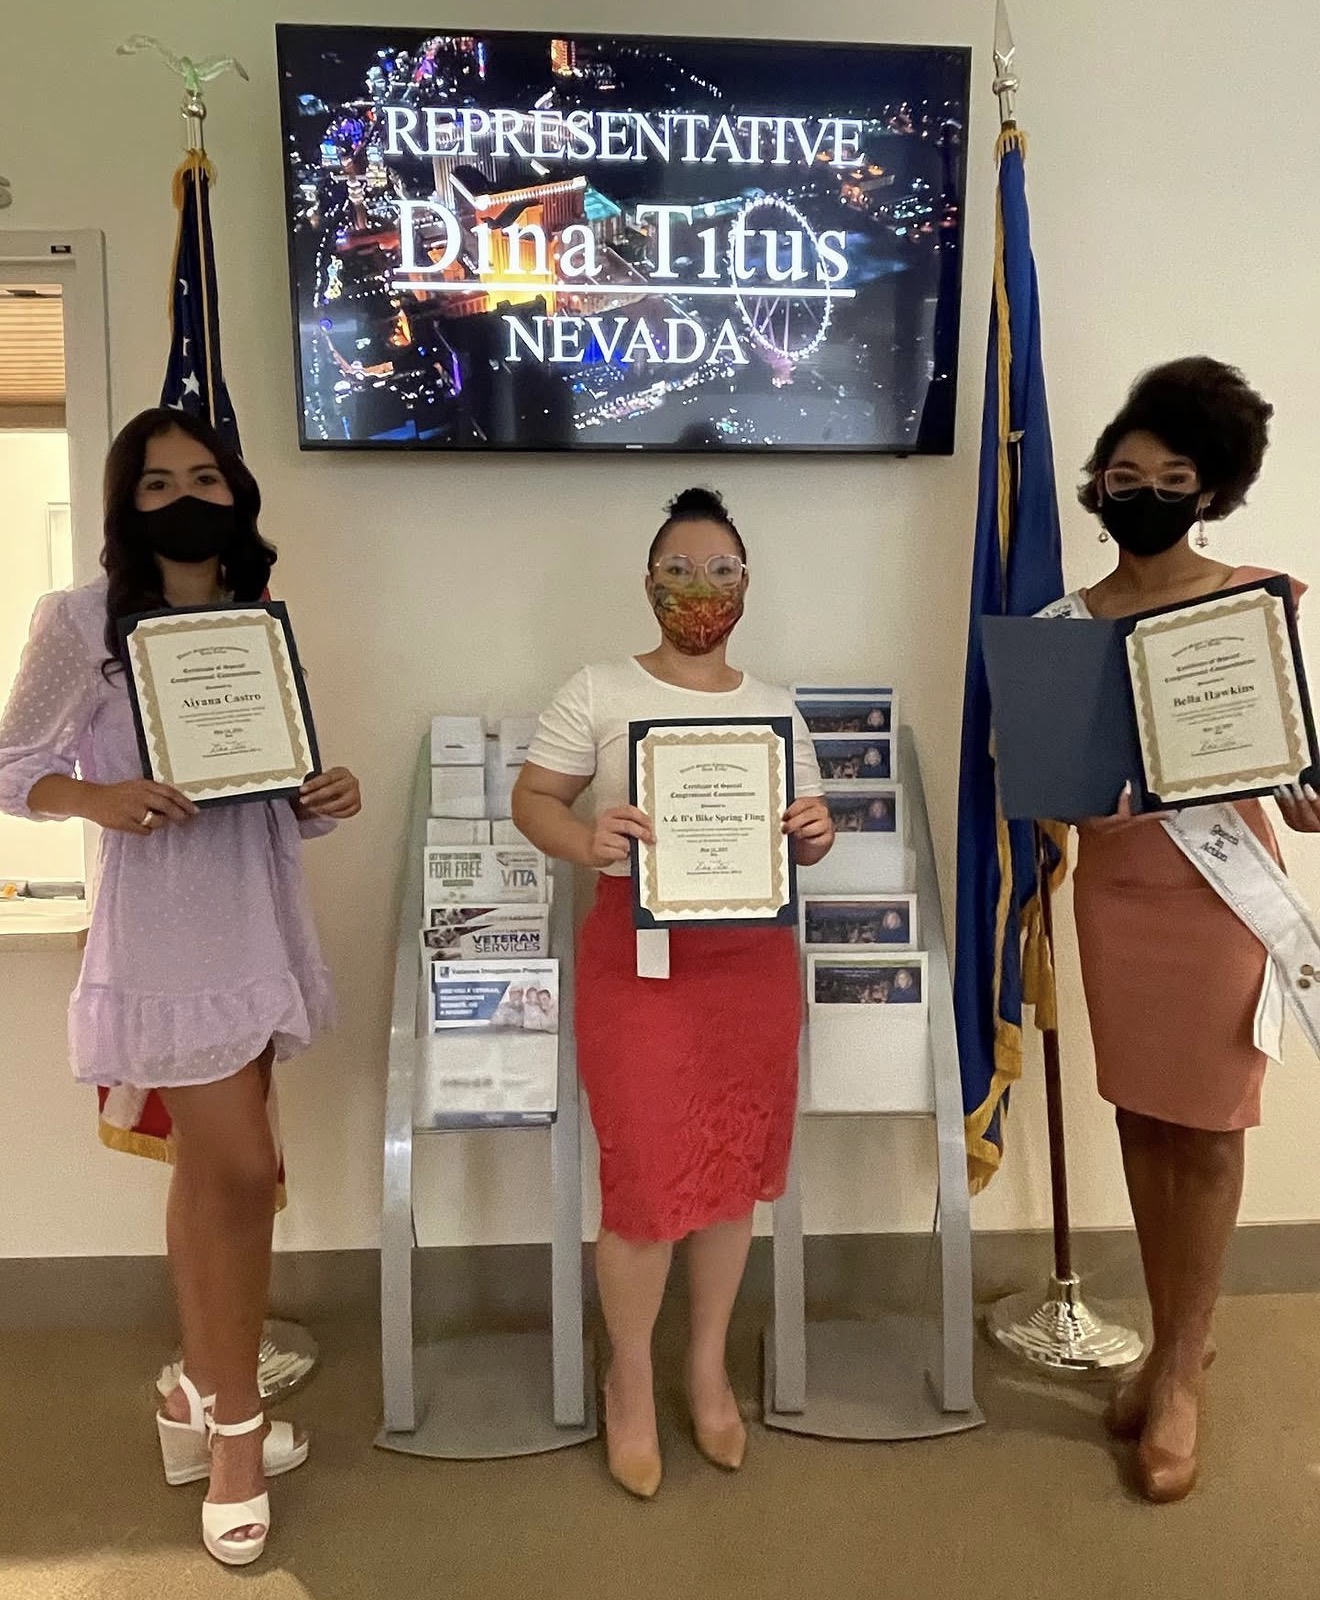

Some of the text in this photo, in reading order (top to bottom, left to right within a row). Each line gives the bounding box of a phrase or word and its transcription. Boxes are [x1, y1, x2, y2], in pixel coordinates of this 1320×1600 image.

[385, 106, 865, 169] REPRESENTATIVE
[394, 200, 850, 283] Dina Titus
[502, 315, 750, 365] NEVADA
[182, 692, 262, 709] Aiyana Castro
[1173, 683, 1255, 708] Bella Hawkins
[670, 815, 678, 823] &
[695, 813, 714, 822] Bike
[715, 813, 743, 824] Spring
[744, 813, 766, 823] Fling
[429, 860, 483, 878] FOR FREE
[501, 870, 538, 887] VITA
[472, 933, 540, 945] VETERAN
[475, 943, 540, 954] SERVICES
